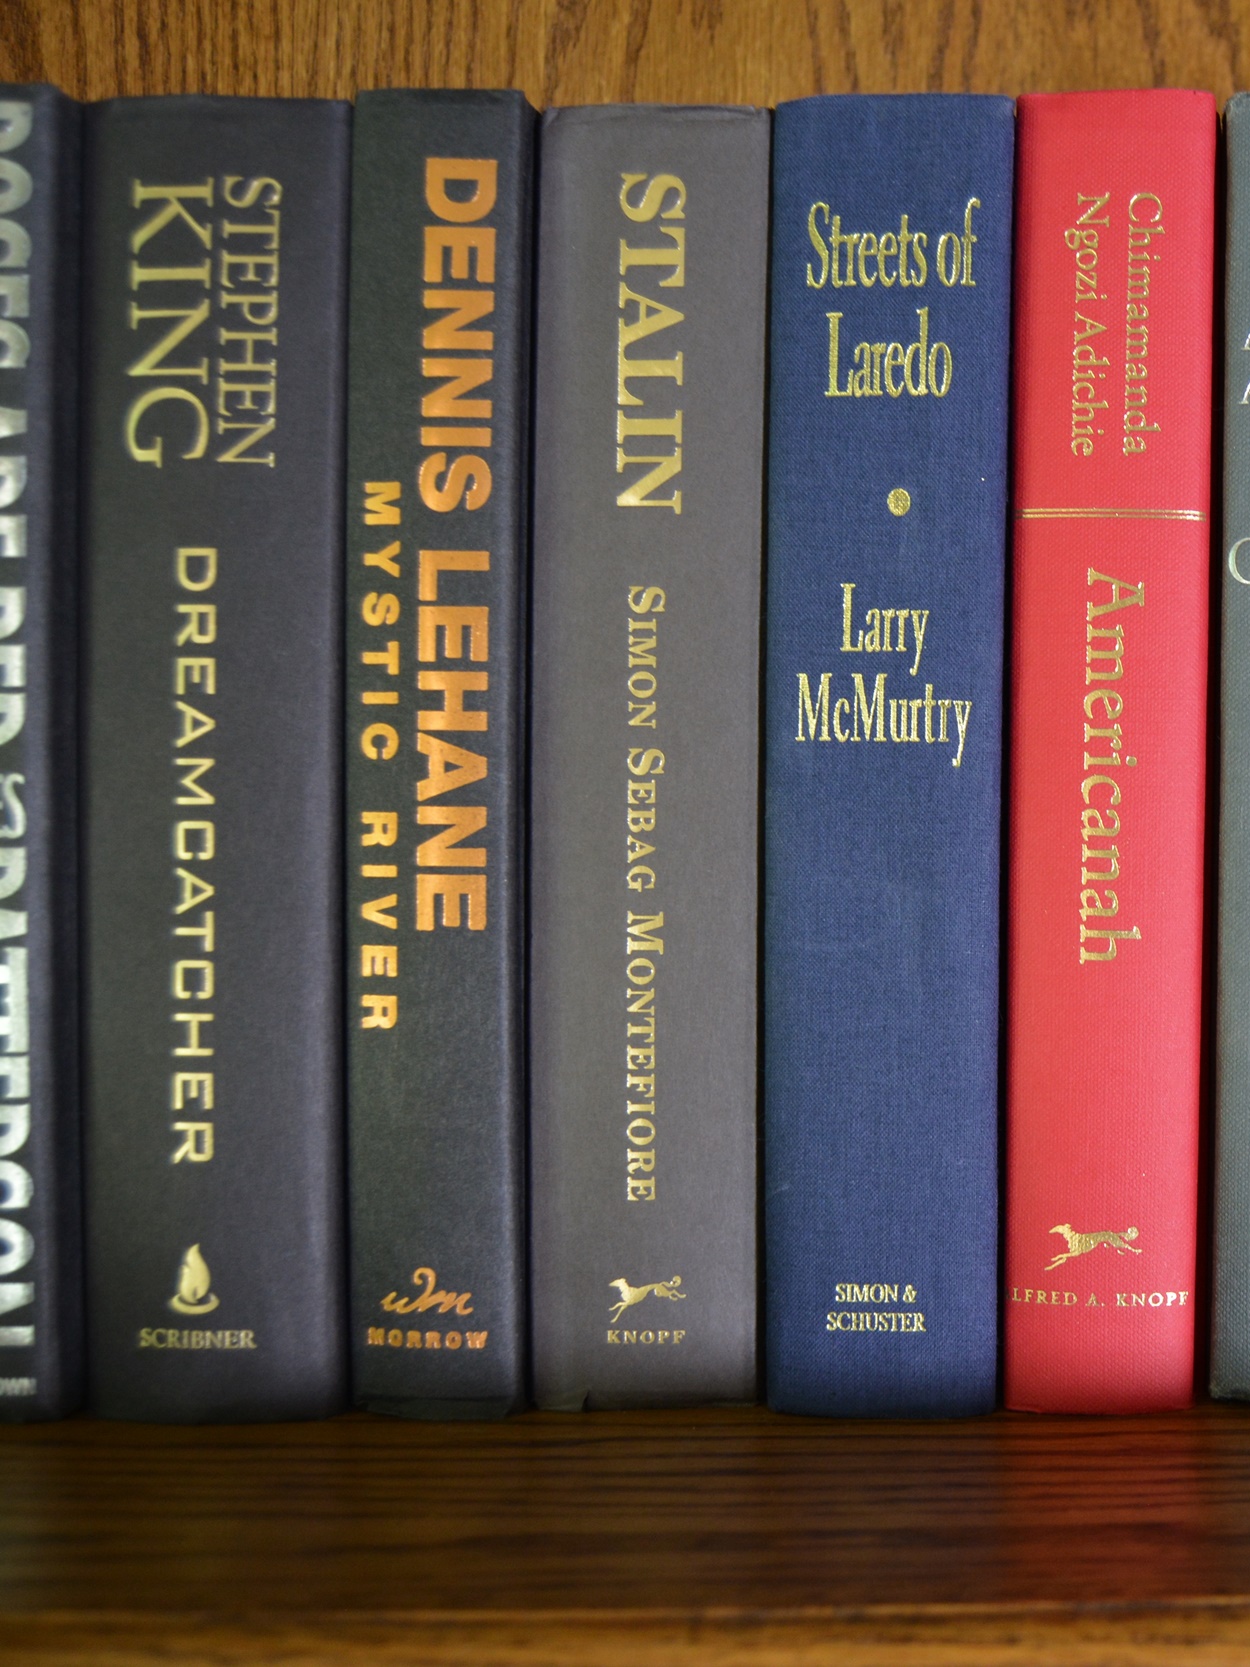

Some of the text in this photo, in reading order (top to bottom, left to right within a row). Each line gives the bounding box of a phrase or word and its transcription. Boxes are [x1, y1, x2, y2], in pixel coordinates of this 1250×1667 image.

[125, 178, 213, 468] KING
[216, 176, 282, 468] STEPHEN
[806, 197, 981, 289] Streets of
[1064, 192, 1110, 456] Ngozi Adichie
[1122, 192, 1165, 456] Chimamanda
[616, 174, 686, 514] STALIN
[824, 307, 953, 398] Laredo
[416, 158, 497, 931] DENNIS LEHANE
[840, 583, 929, 676] Larry
[361, 482, 401, 1029] MYSTIC RIVER
[795, 673, 972, 767] McMurtry
[1079, 568, 1145, 964] Americanah
[172, 548, 217, 1163] DREAMCATCHER
[626, 586, 666, 1201] SIMON SEBAG MONTEFIORE
[140, 1328, 257, 1349] SCRIBNER
[368, 1327, 488, 1349] MORROW
[607, 1330, 686, 1344] KNOPF
[826, 1312, 926, 1332] SCHUSTER
[835, 1283, 917, 1303] SIMON &
[1007, 1287, 1078, 1306] LFRED
[1116, 1291, 1188, 1307] KNOPF
